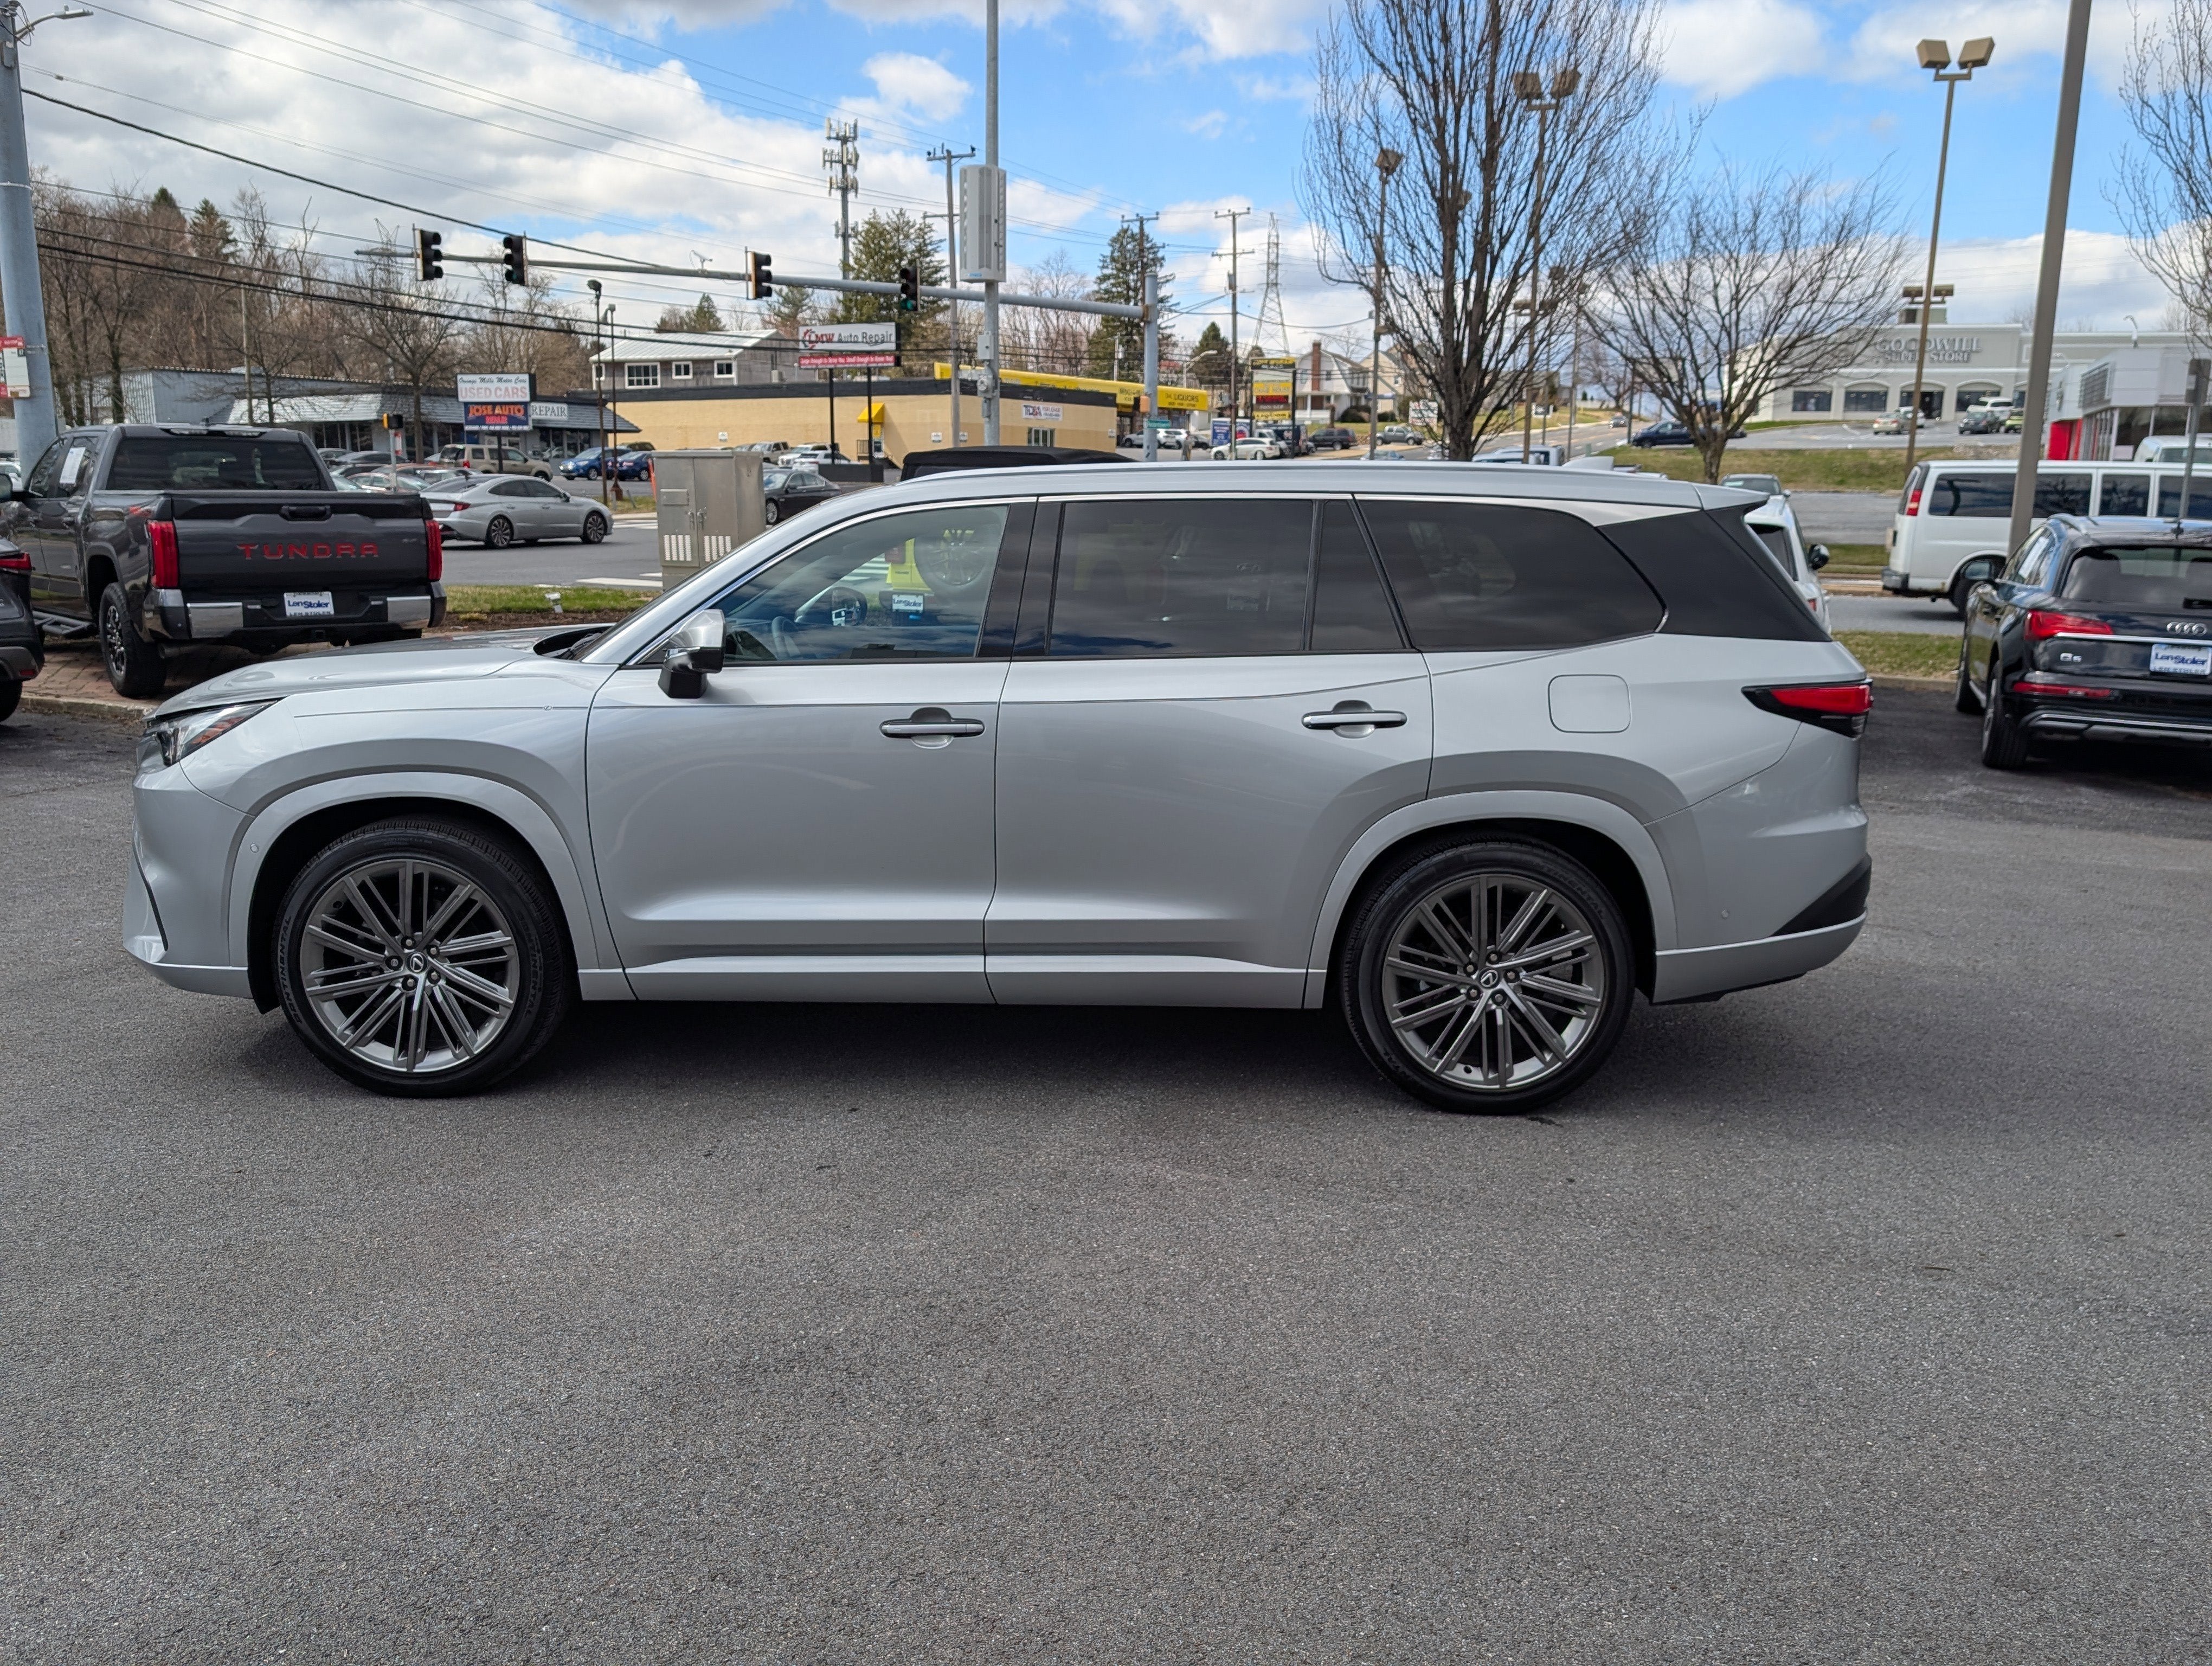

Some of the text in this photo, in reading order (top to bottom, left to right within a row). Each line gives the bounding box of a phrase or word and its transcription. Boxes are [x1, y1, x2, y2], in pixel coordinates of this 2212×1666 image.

[838, 332, 859, 342] Auto
[861, 331, 893, 344] Repair
[1930, 351, 1970, 362] STORE
[460, 386, 528, 399] USED CARS
[468, 405, 525, 418] JOSE AUTO
[531, 405, 567, 416] REPAIR
[236, 543, 379, 560] TUNDRA
[279, 915, 303, 1024] CONTINENTAL
